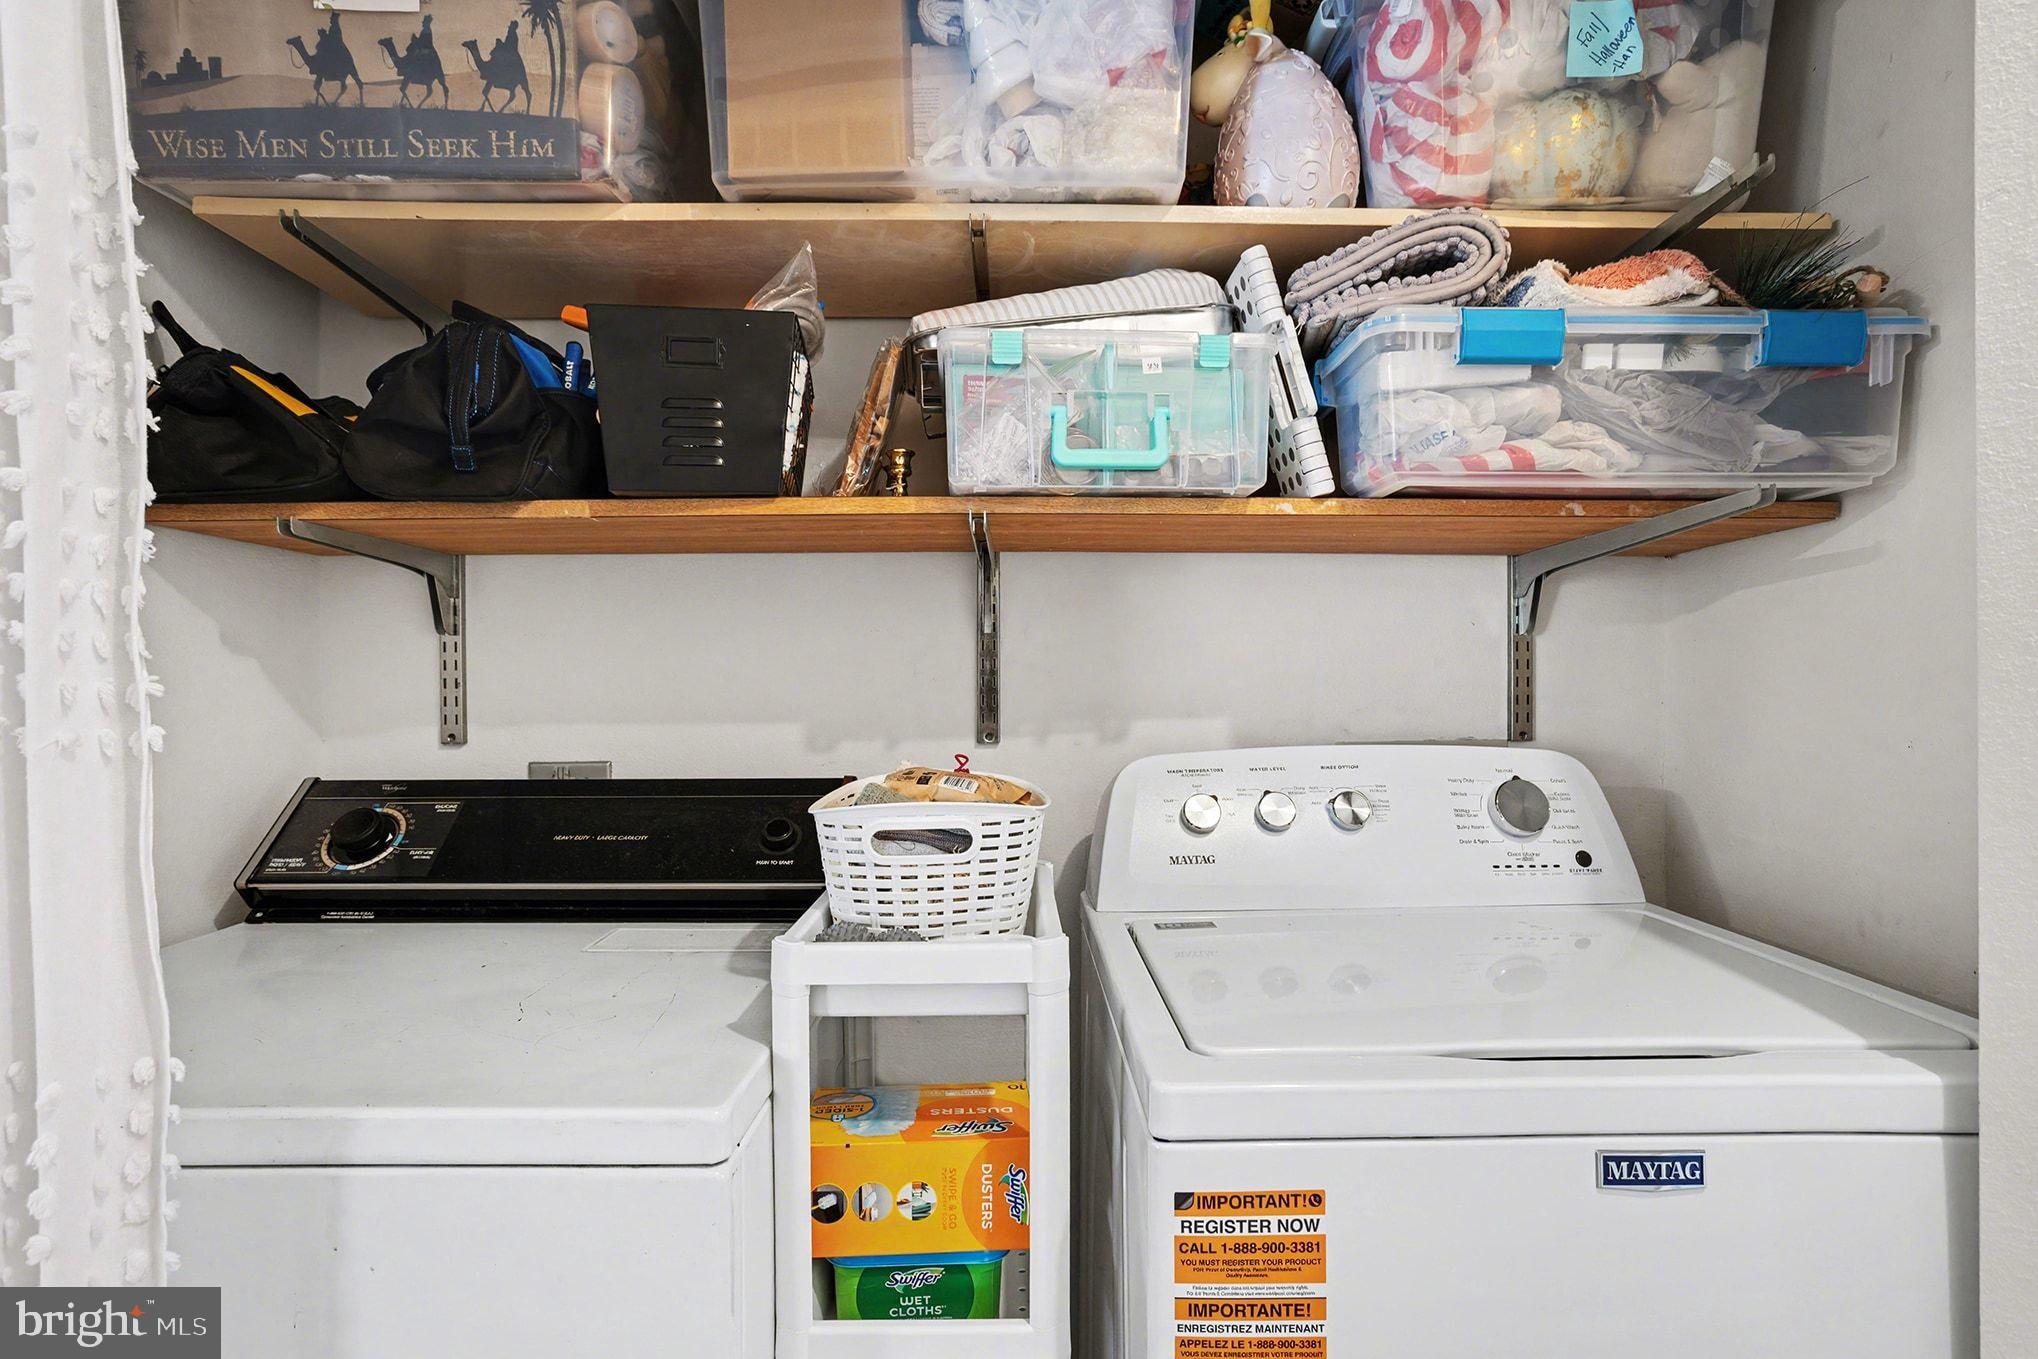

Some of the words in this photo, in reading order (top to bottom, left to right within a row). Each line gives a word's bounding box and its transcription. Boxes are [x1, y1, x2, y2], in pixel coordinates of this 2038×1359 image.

[1169, 855, 1215, 865] MAYTAG
[930, 1106, 1013, 1116] DUSTERS
[934, 1119, 1015, 1134] Swiffer
[1607, 1161, 1701, 1180] MAYTAG
[981, 1163, 993, 1229] DUSTERS
[1004, 1163, 1027, 1224] Swiffer
[1197, 1193, 1307, 1210] IMPORTANT!
[1180, 1219, 1271, 1234] REGISTER
[1277, 1218, 1321, 1233] NOW
[1179, 1243, 1217, 1254] CALL
[1221, 1241, 1321, 1254] 1-888-900-3381
[885, 1271, 942, 1290] Swiffer
[900, 1296, 931, 1306] WET
[889, 1305, 942, 1317] CLOTHS
[1188, 1303, 1311, 1317] IMPORTANTE!
[1177, 1324, 1251, 1333] ENREGISTREZ
[1255, 1324, 1324, 1333] MAINTENANT
[1179, 1339, 1228, 1348] APPELEZ
[1231, 1340, 1244, 1348] LE
[1248, 1340, 1322, 1348] 1-888-900-3381
